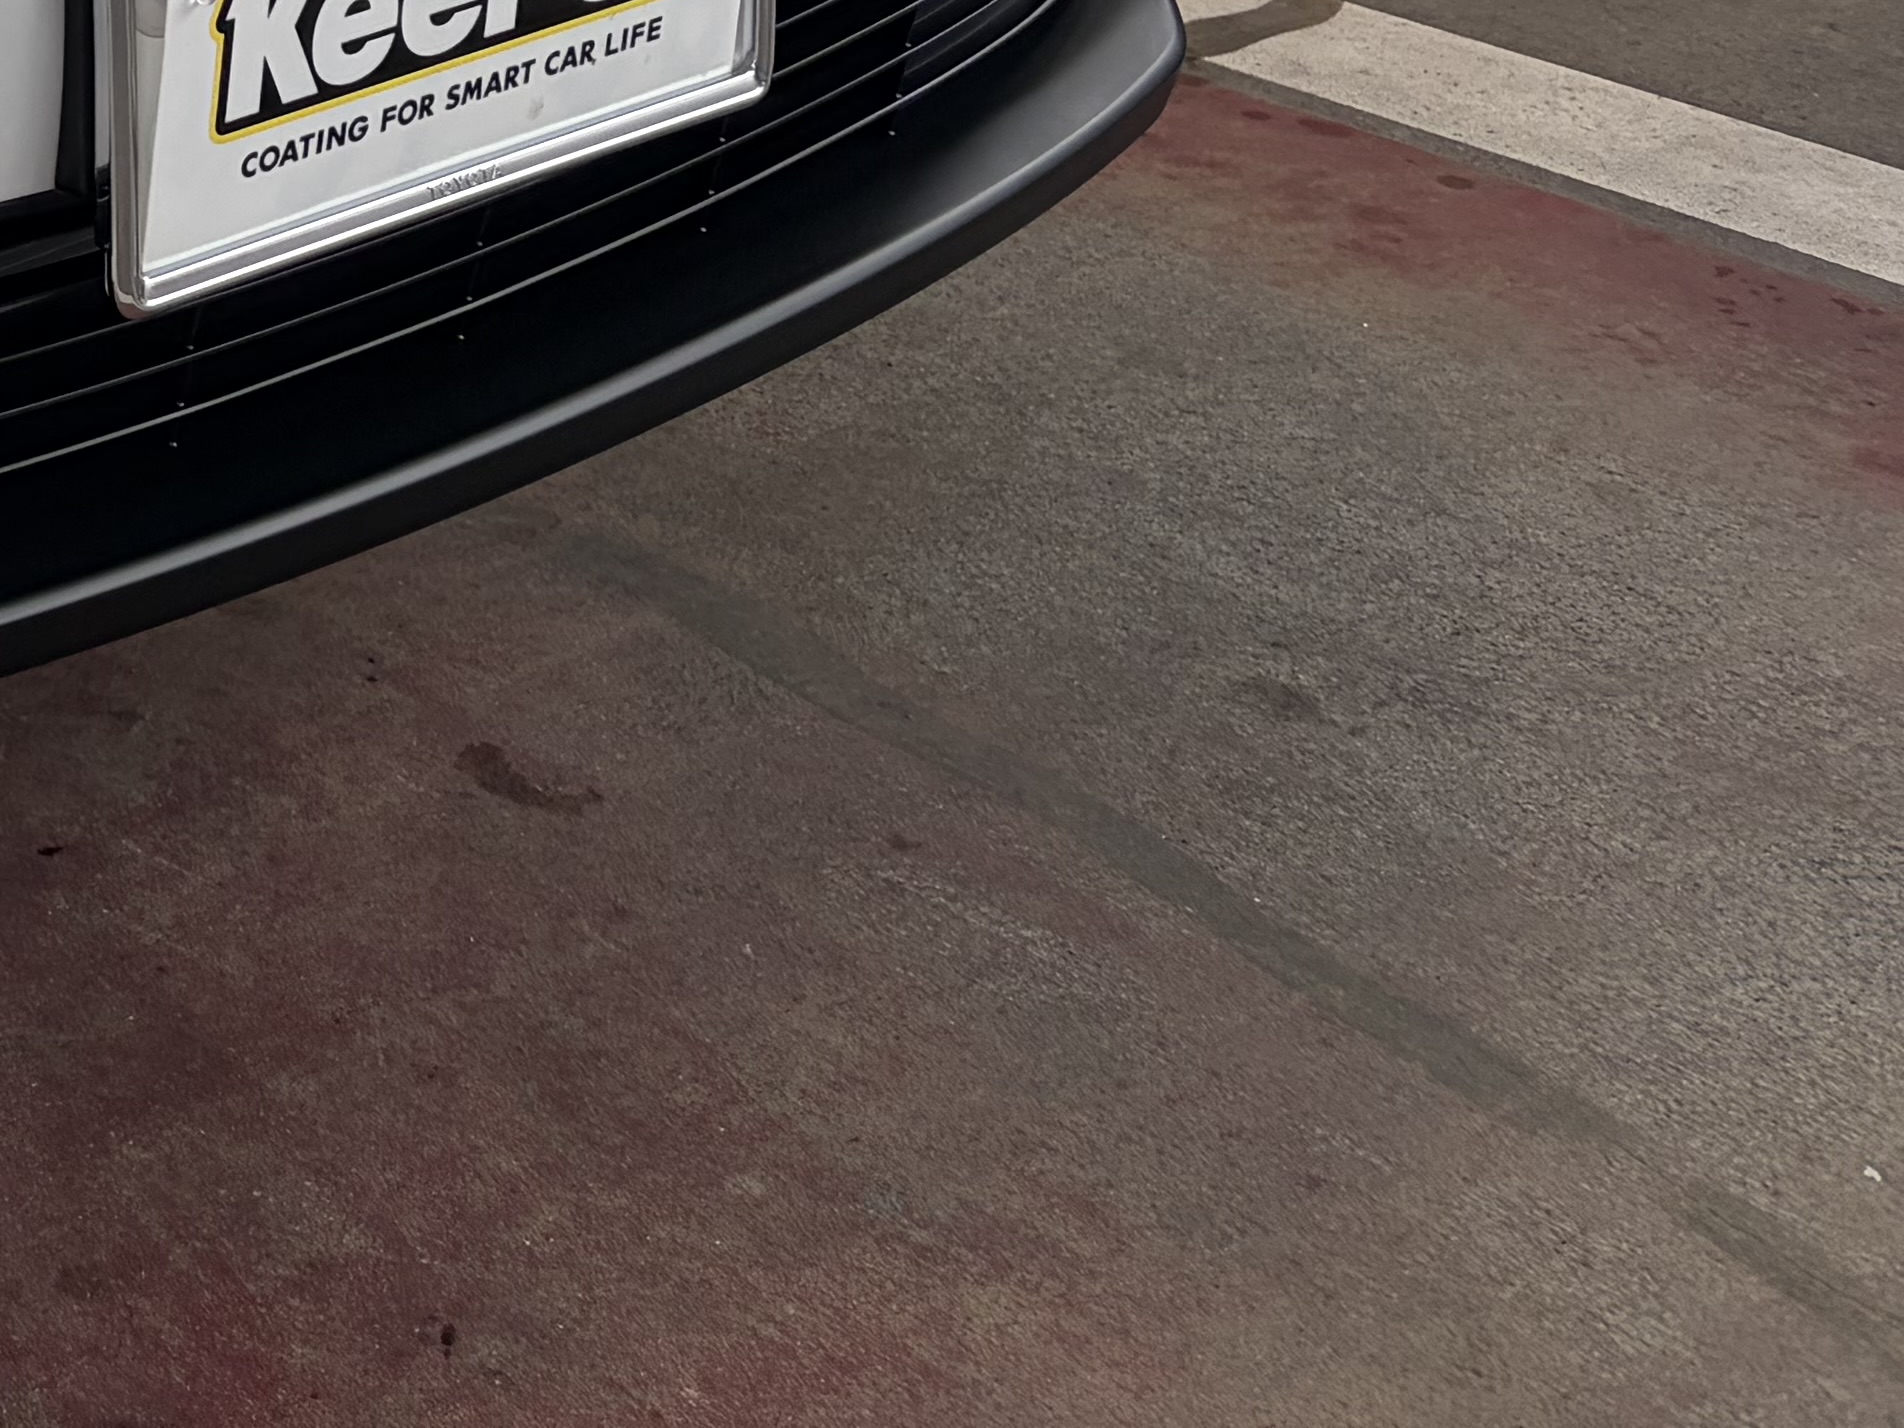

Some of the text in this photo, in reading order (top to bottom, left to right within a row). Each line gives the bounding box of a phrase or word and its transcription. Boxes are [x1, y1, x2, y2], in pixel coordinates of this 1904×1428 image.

[240, 16, 663, 178] COATING FOR SMART CAR LIFE
